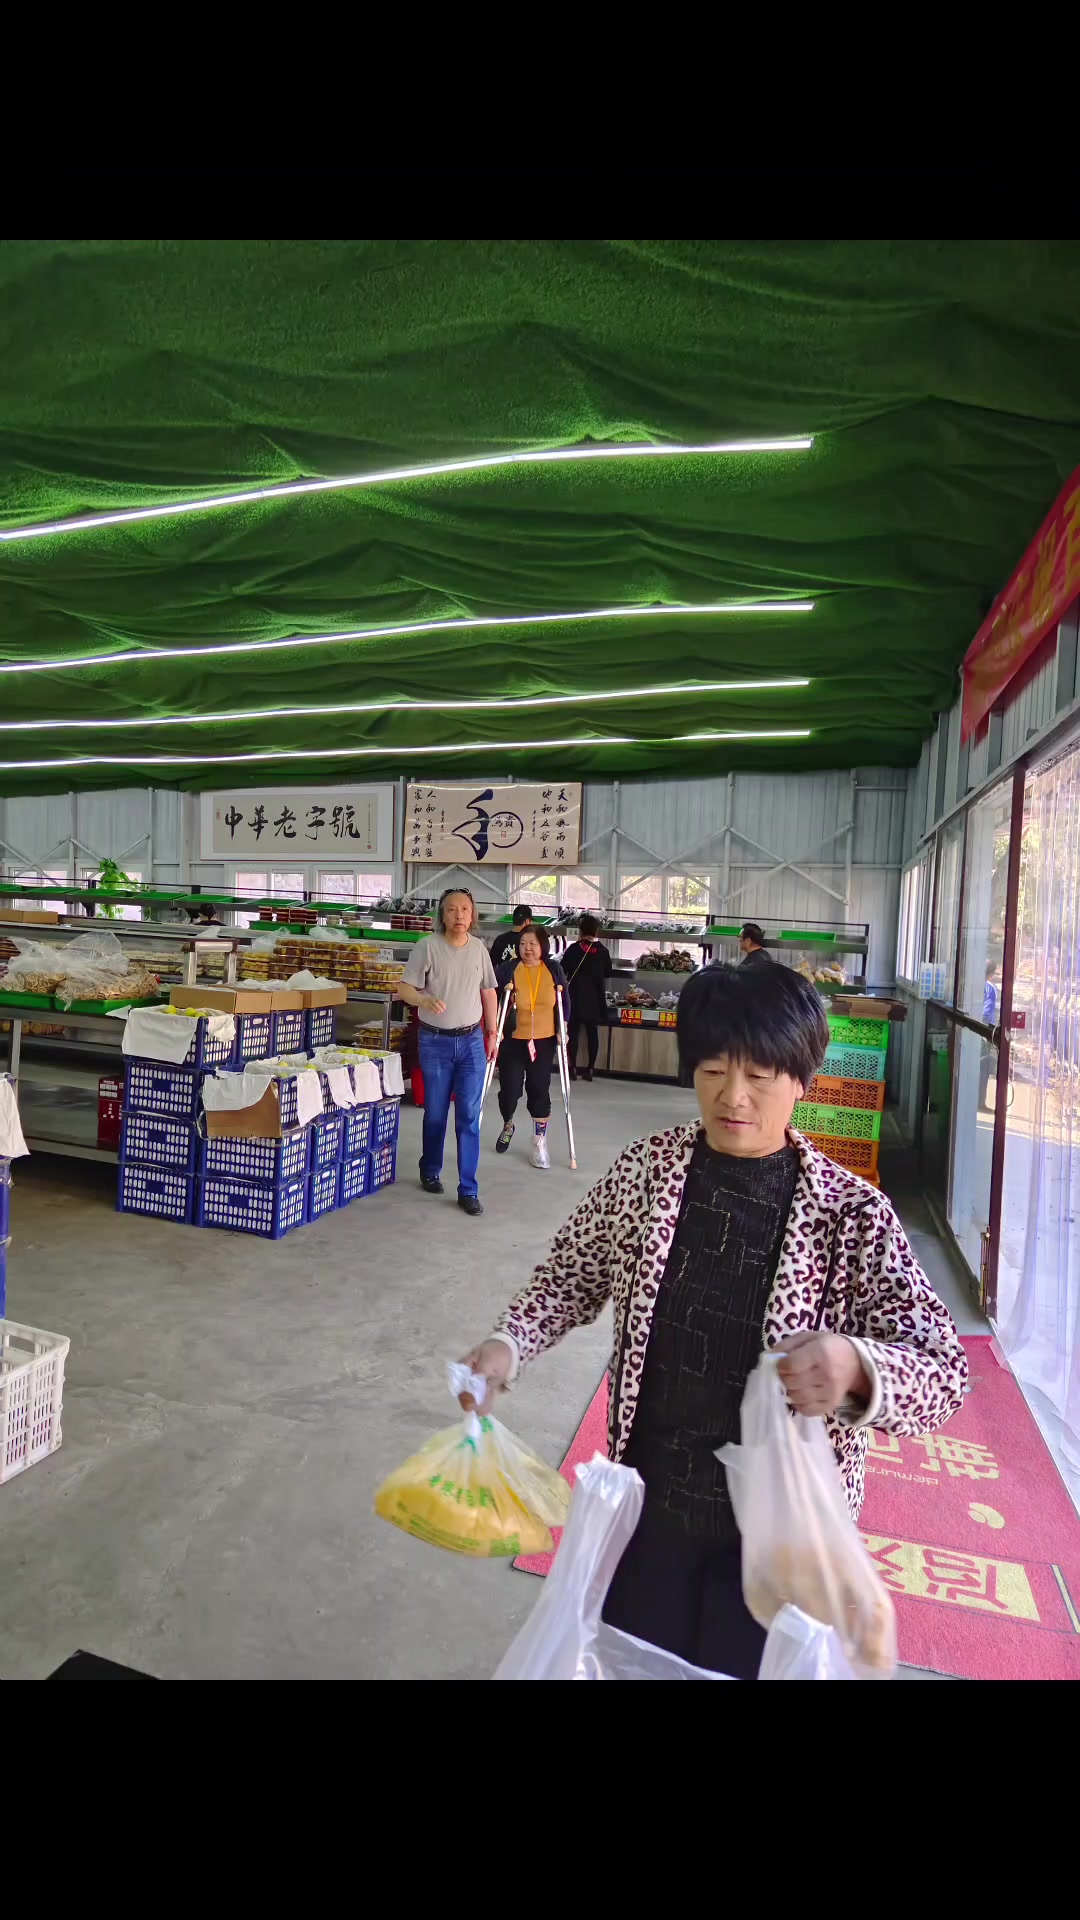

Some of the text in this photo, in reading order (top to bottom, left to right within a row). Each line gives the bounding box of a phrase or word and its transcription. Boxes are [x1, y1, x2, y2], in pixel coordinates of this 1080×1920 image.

[224, 804, 361, 841] 中華老字號
